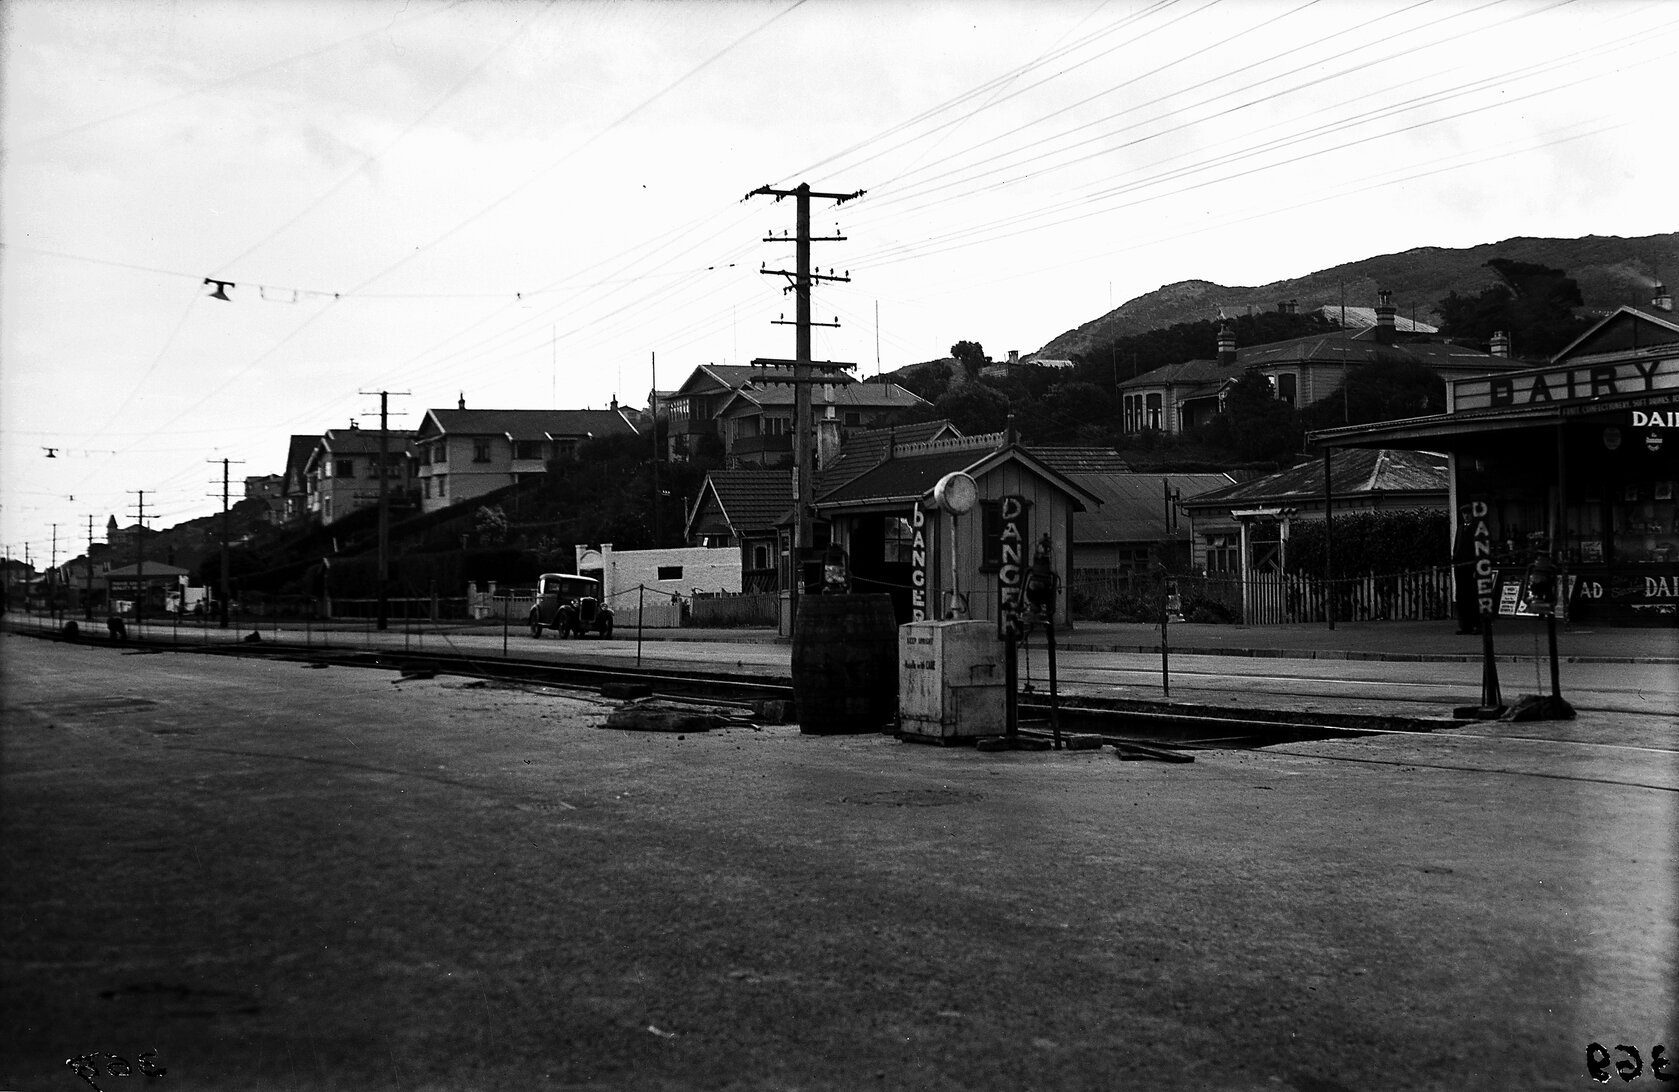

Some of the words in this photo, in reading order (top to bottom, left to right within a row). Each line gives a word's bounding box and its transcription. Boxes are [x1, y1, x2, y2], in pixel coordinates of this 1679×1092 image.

[1490, 360, 1661, 407] DAIRY
[1632, 411, 1679, 427] DAI
[999, 497, 1022, 635] DANGER
[1472, 501, 1493, 614] DANGER
